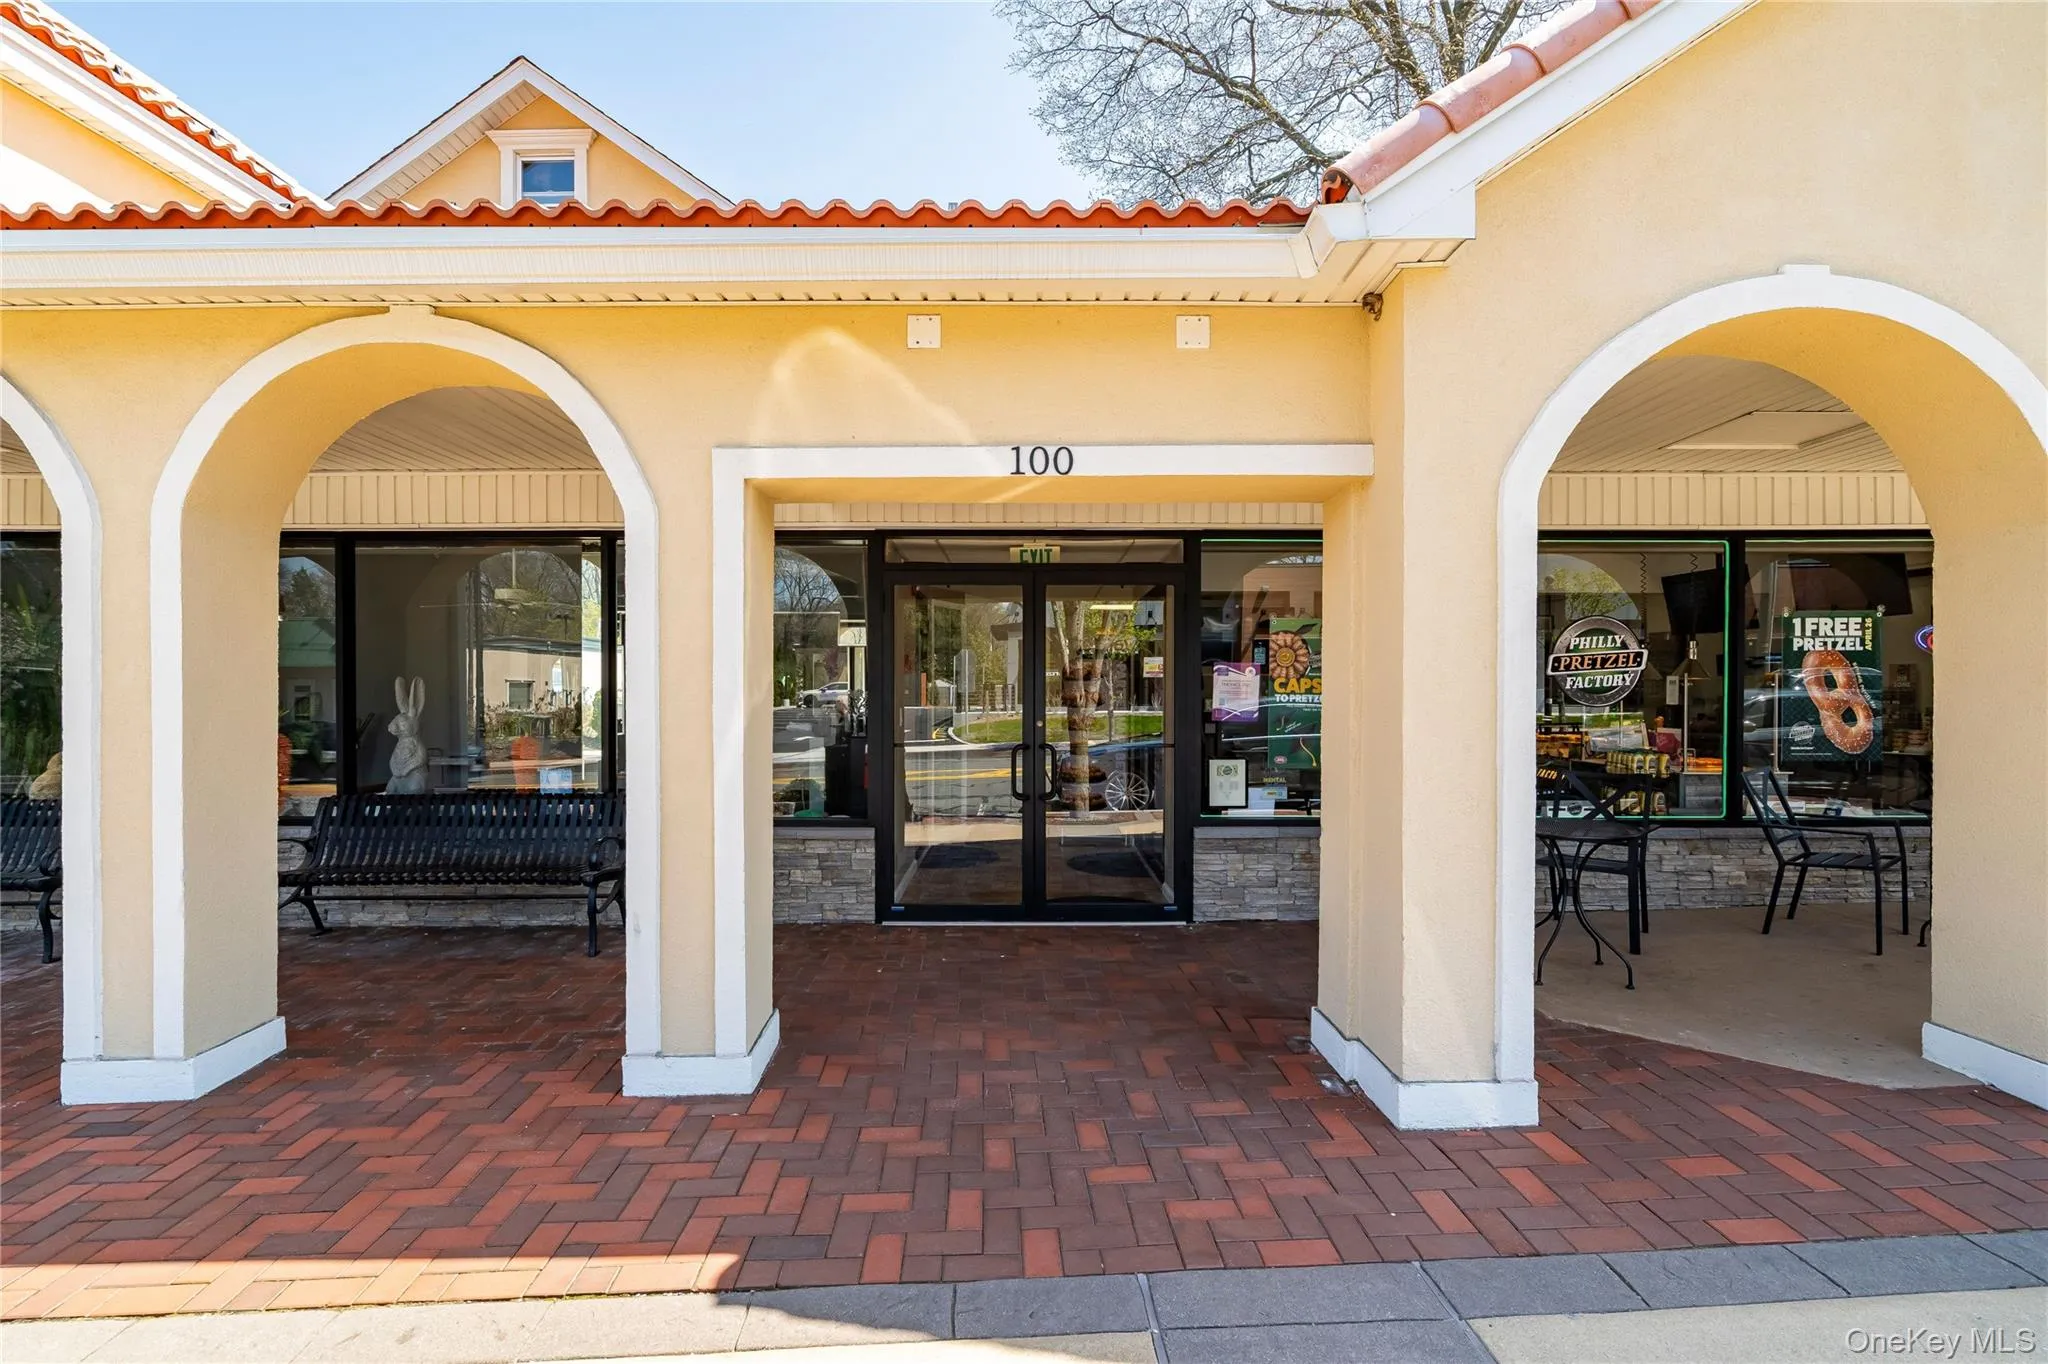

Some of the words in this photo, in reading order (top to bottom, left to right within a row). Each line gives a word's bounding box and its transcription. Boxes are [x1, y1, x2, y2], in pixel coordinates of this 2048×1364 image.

[1010, 446, 1074, 475] 100
[1019, 549, 1052, 565] EXIT
[1792, 617, 1802, 637] 1
[1805, 617, 1863, 637] FREE
[1865, 617, 1873, 628] 26
[1569, 635, 1626, 650] PHILLY
[1793, 637, 1864, 651] PRETZEL
[1865, 629, 1873, 651] APRIL
[1558, 653, 1638, 670] PRETZEL
[1273, 676, 1322, 694] CAPS
[1565, 673, 1634, 689] FACTORY
[1274, 694, 1289, 703] TO
